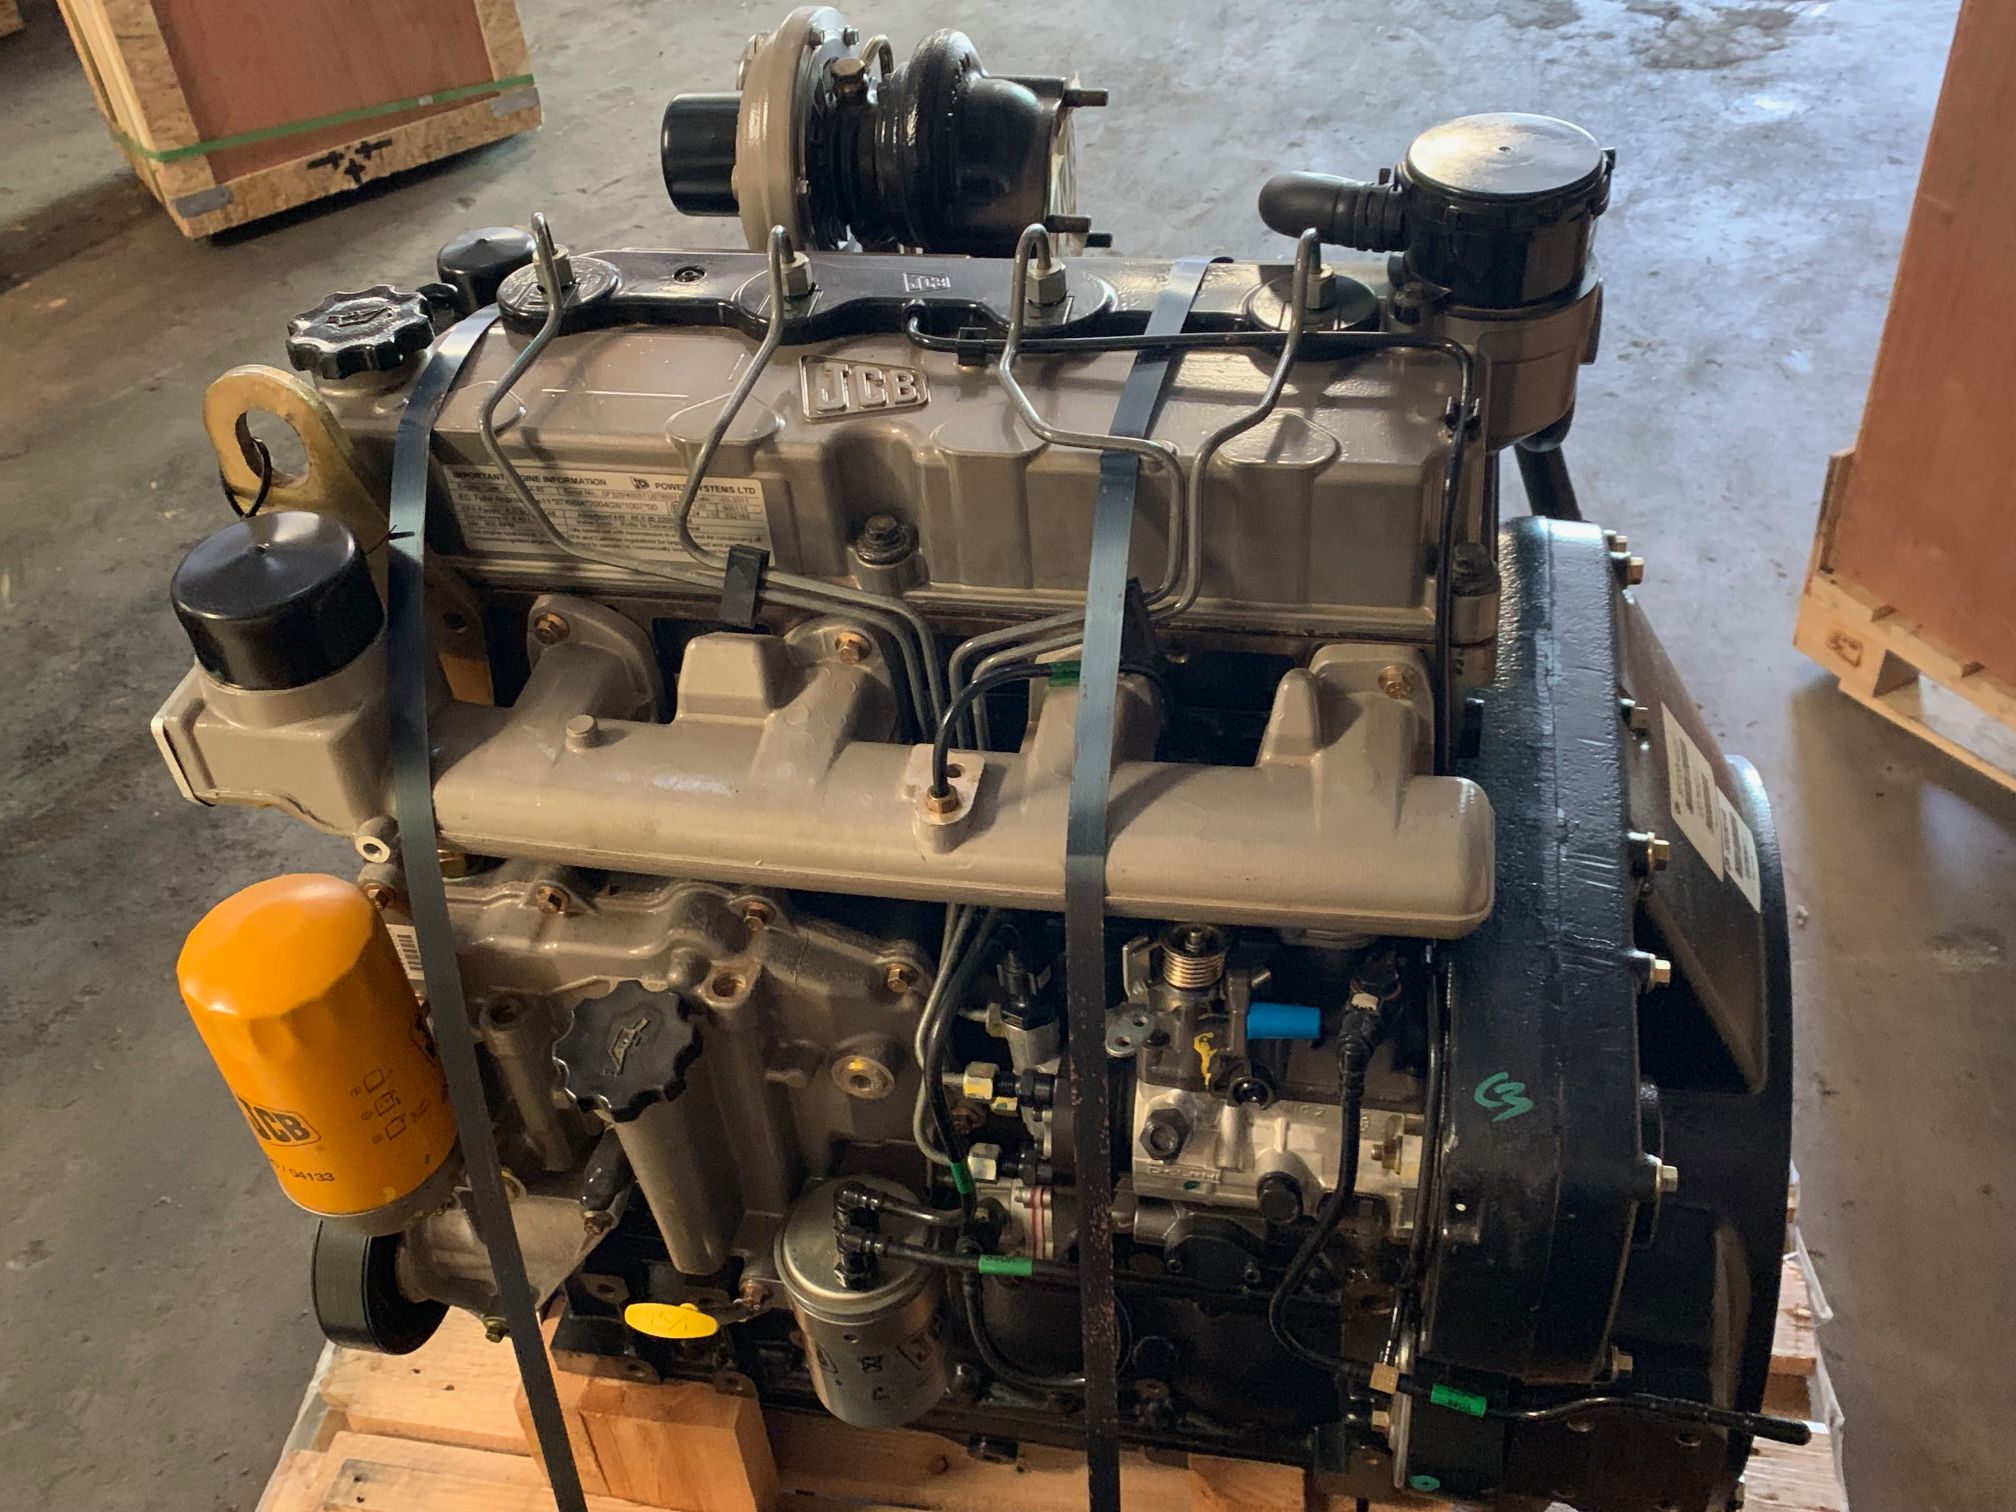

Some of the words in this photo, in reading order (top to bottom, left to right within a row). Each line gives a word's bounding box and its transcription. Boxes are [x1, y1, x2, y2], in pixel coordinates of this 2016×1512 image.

[815, 361, 918, 412] JCB
[452, 471, 504, 482] IMPORTANT
[543, 476, 607, 486] INFORMATION
[655, 482, 685, 492] POWE
[700, 484, 735, 494] YSTEMS
[737, 487, 756, 495] LTD
[237, 1096, 311, 1143] JCB
